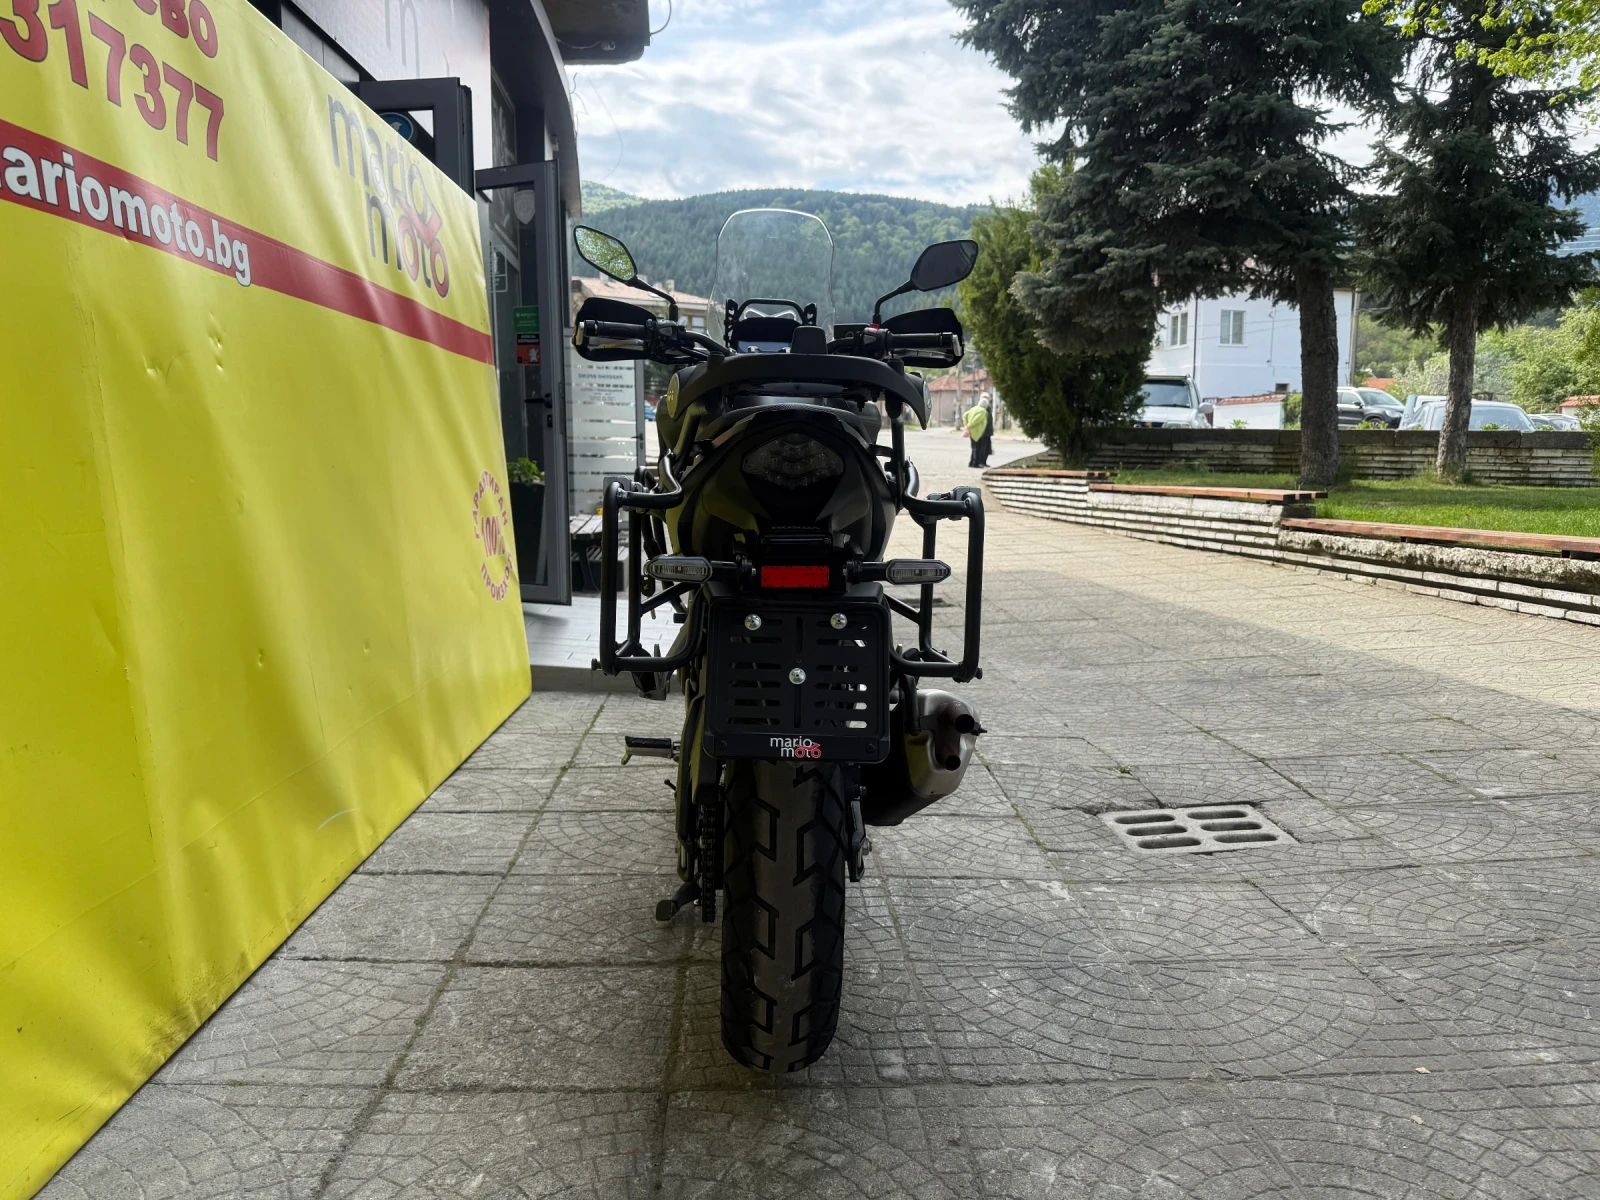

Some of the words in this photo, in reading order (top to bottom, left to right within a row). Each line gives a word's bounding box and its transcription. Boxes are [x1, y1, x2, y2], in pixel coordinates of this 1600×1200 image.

[0, 0, 224, 162] 317377
[133, 0, 218, 58] ВО
[328, 94, 430, 224] mario
[0, 145, 251, 287] ariomoto.bg
[365, 191, 449, 298] moto
[770, 735, 813, 748] mario
[780, 746, 821, 759] moto
